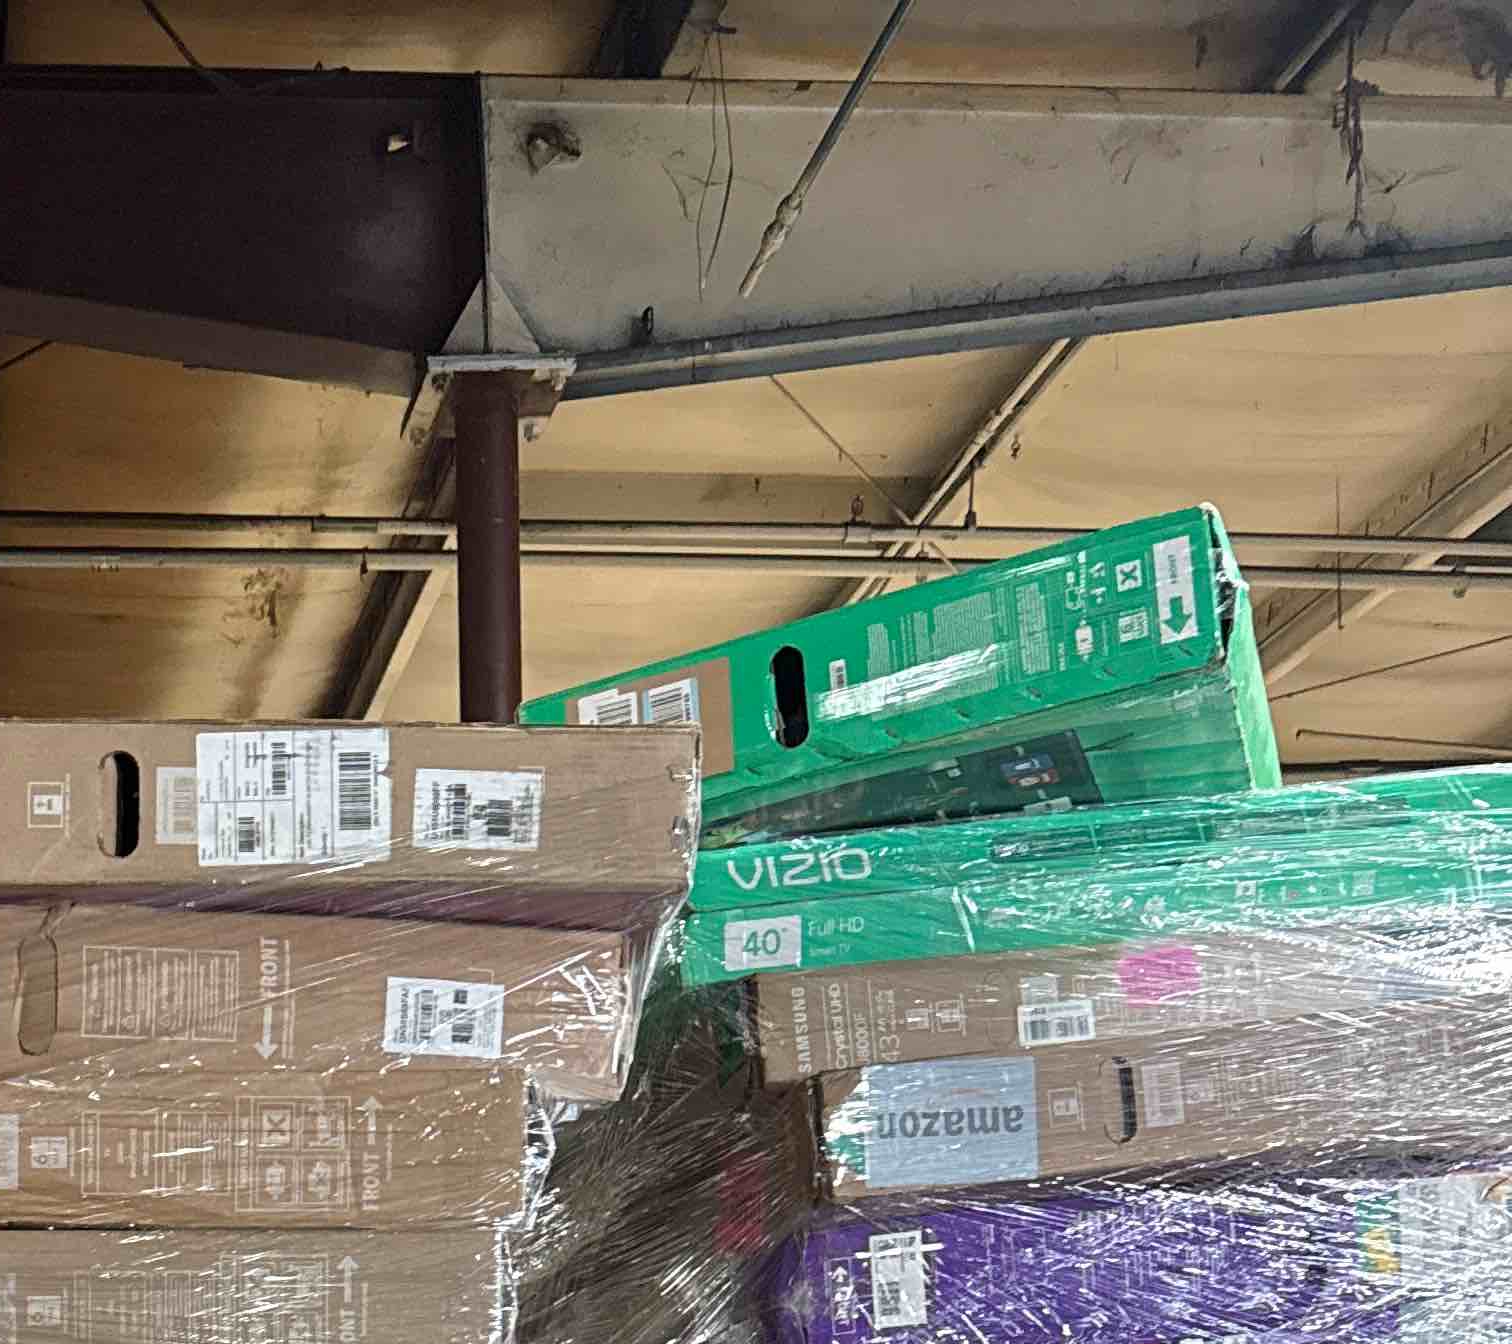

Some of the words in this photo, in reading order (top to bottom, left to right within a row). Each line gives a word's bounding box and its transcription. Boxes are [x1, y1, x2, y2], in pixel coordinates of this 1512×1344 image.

[727, 847, 873, 890] VIZIO
[260, 936, 279, 1000] FRONT
[791, 986, 812, 1074] SAMSUNG
[876, 1103, 1025, 1140] amazon
